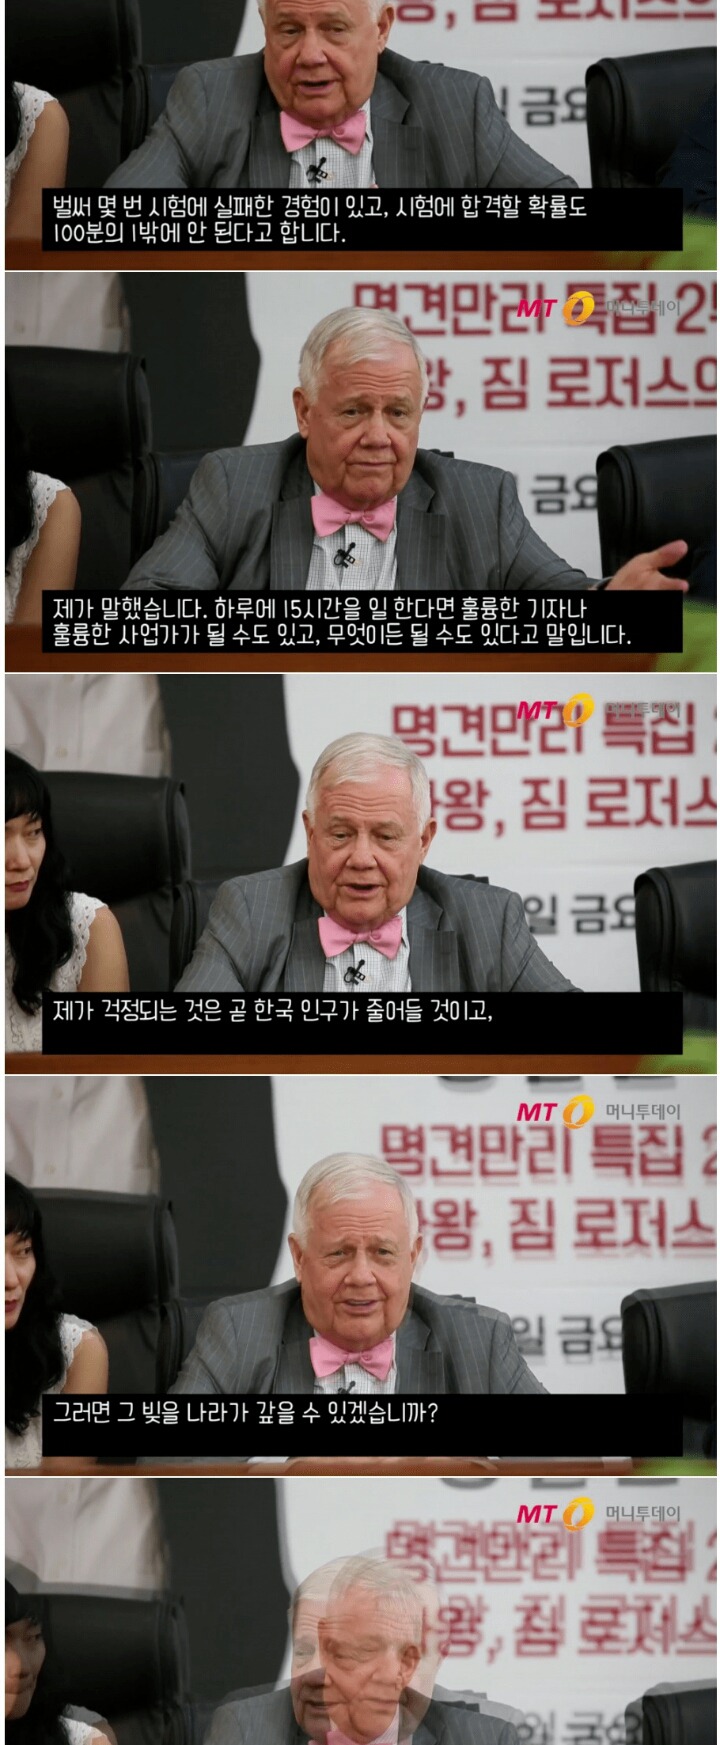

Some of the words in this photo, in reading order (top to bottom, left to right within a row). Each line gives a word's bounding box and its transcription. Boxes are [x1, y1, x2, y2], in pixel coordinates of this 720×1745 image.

[483, 357, 528, 411] 짐
[392, 703, 583, 757] 명견만리
[522, 777, 567, 832] 짐
[381, 1124, 572, 1178] 명견만리
[591, 1124, 684, 1178] 특집
[510, 1198, 555, 1252] 짐
